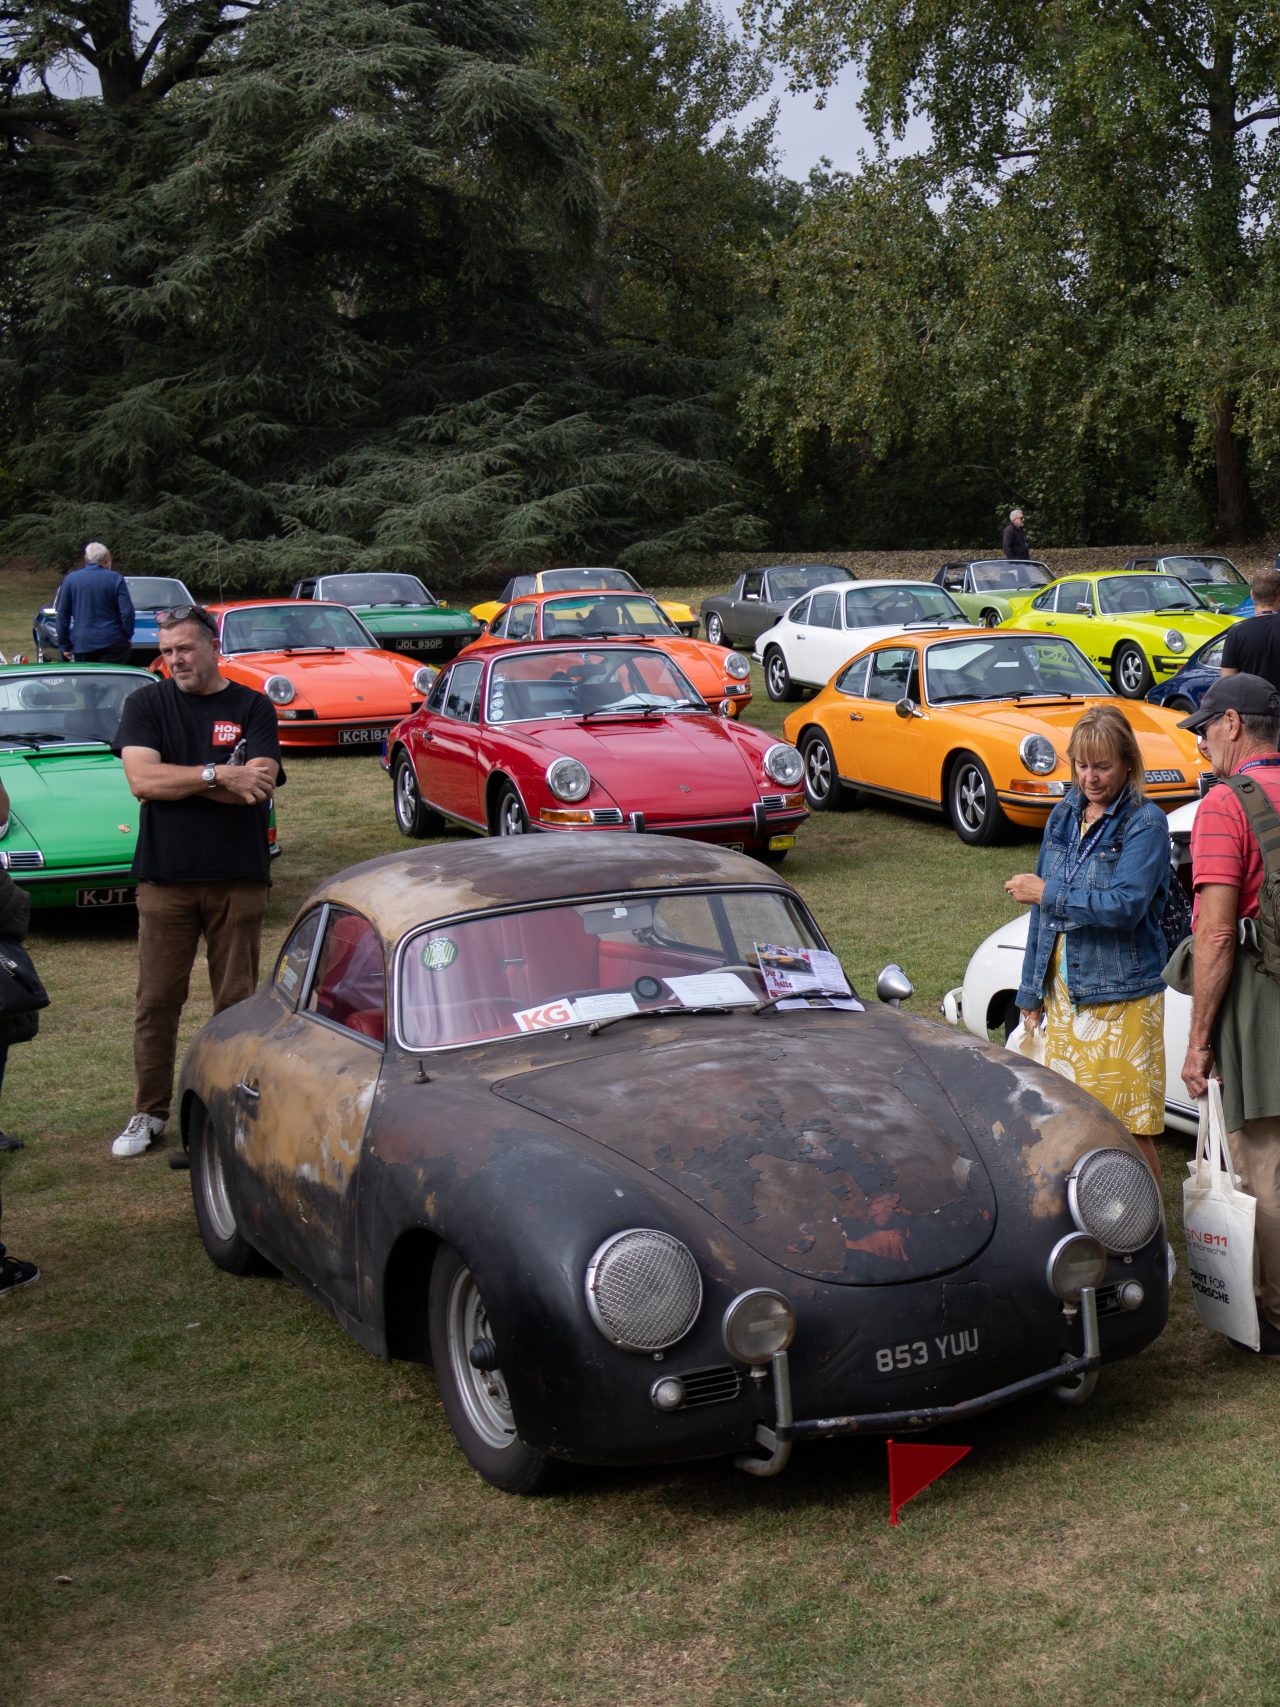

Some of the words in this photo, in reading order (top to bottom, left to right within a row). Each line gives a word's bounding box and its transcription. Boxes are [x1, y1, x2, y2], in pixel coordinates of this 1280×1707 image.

[214, 724, 241, 734] HOP
[218, 733, 237, 741] UP
[83, 887, 128, 905] KJT
[521, 1004, 571, 1031] KG
[1203, 1232, 1228, 1248] 911
[1209, 1275, 1226, 1291] FOR
[875, 1341, 929, 1373] 853
[935, 1327, 980, 1360] YUU
